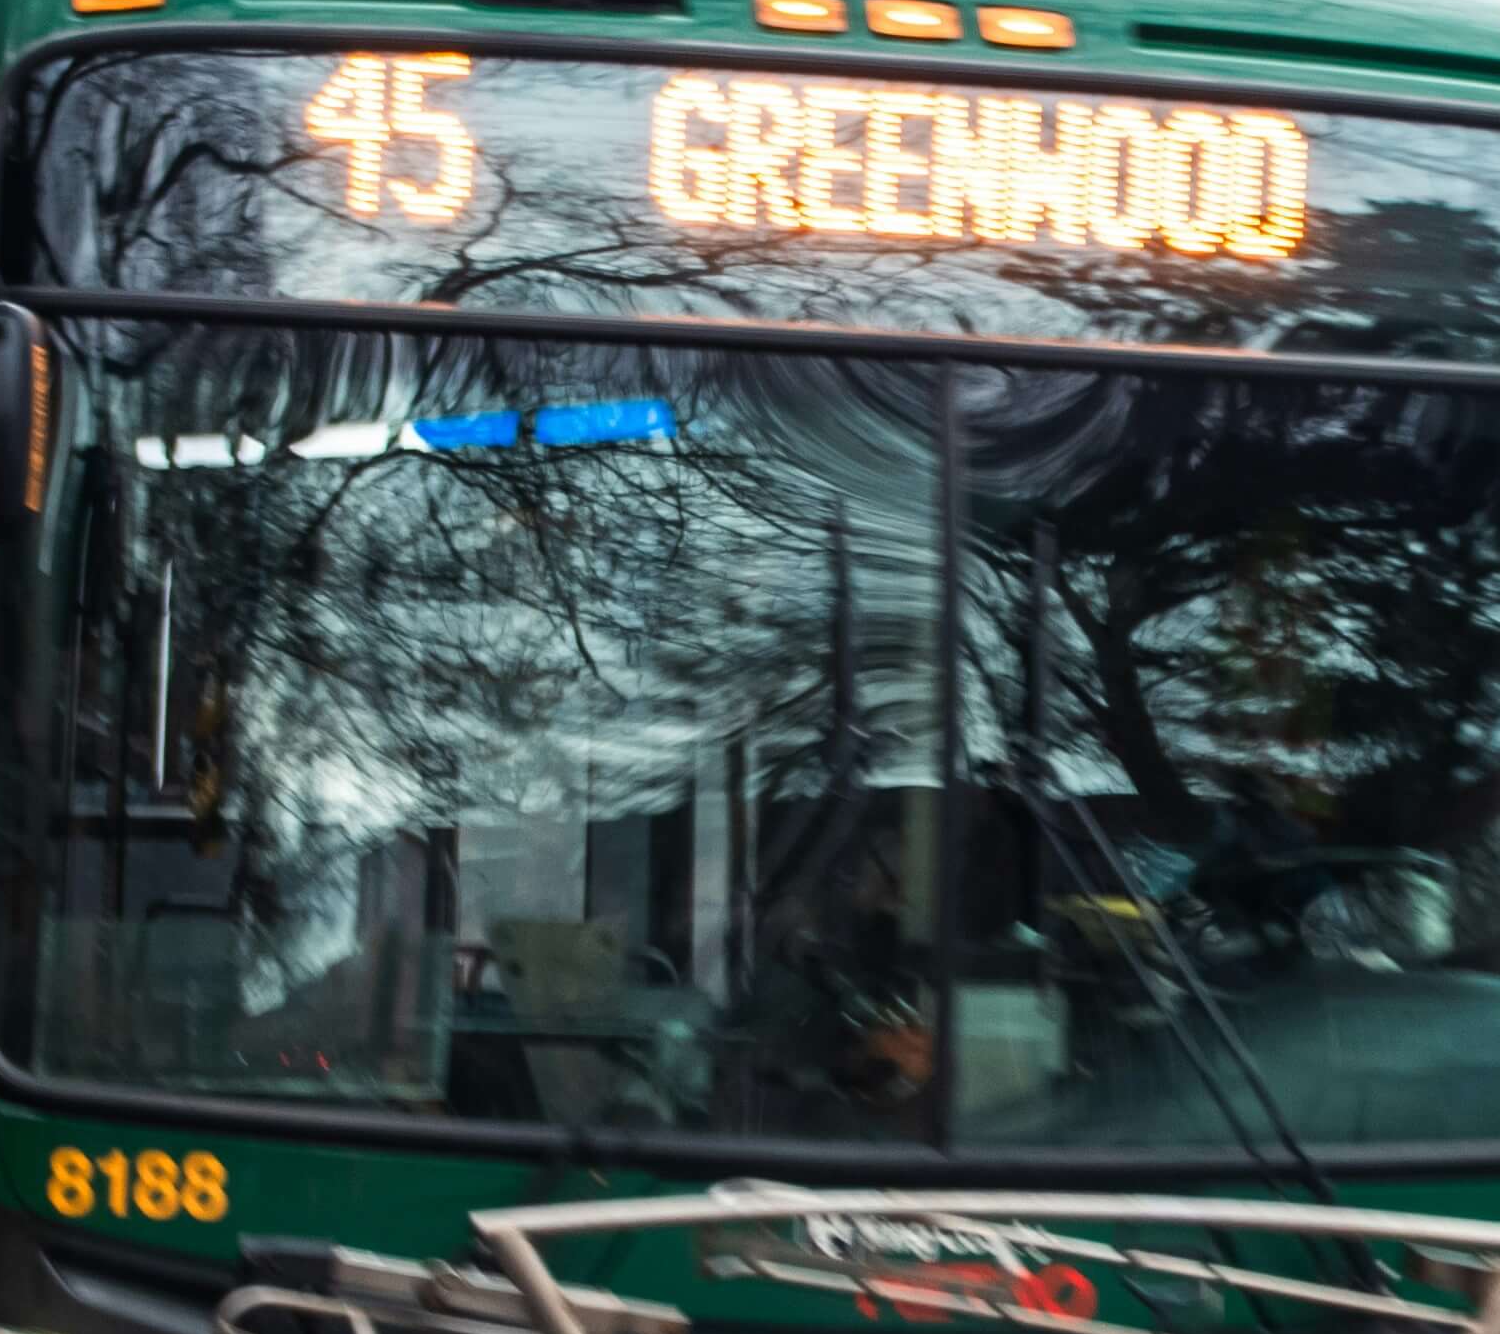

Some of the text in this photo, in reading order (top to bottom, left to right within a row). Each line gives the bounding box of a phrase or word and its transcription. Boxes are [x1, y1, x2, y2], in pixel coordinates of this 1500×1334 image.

[306, 52, 1308, 259] 45 GREENWOOD
[46, 1145, 229, 1224] 8188
